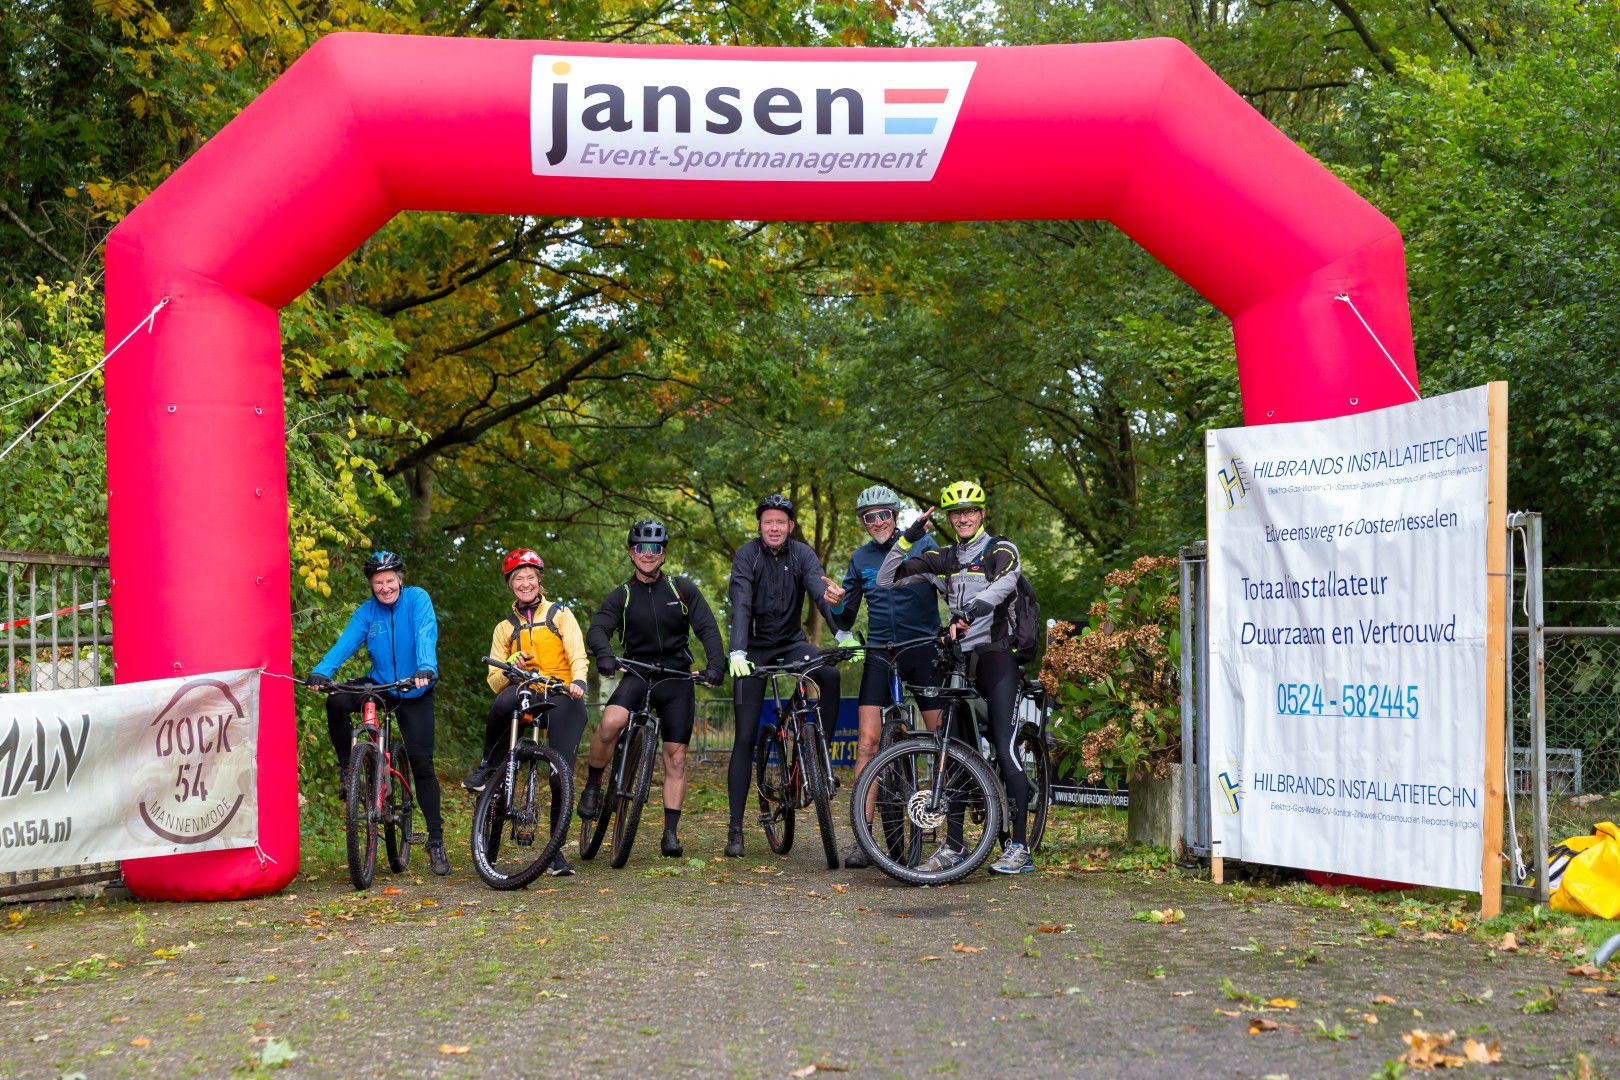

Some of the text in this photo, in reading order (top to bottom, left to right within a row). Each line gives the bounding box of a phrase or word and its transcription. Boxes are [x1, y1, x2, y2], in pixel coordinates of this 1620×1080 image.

[545, 61, 864, 166] jansen
[580, 143, 928, 174] Event-Sportmanagement
[1253, 430, 1488, 479] HILBRANDS INSTALLATIETECHNIE
[1338, 521, 1354, 537] 16
[1355, 507, 1458, 535] Oosterhesselen
[1241, 571, 1388, 600] Totaalinstallateur
[1241, 614, 1456, 645] Duurzaam en Vertrouwd
[1277, 683, 1324, 715] 0524
[1342, 684, 1419, 718] 582445
[156, 714, 233, 757] DOCK
[174, 763, 208, 803] 54
[1253, 772, 1477, 808] HILBRANDS INSTALLATIETECHN
[0, 816, 72, 848] ck54.nl
[149, 797, 231, 833] MANNENMODE
